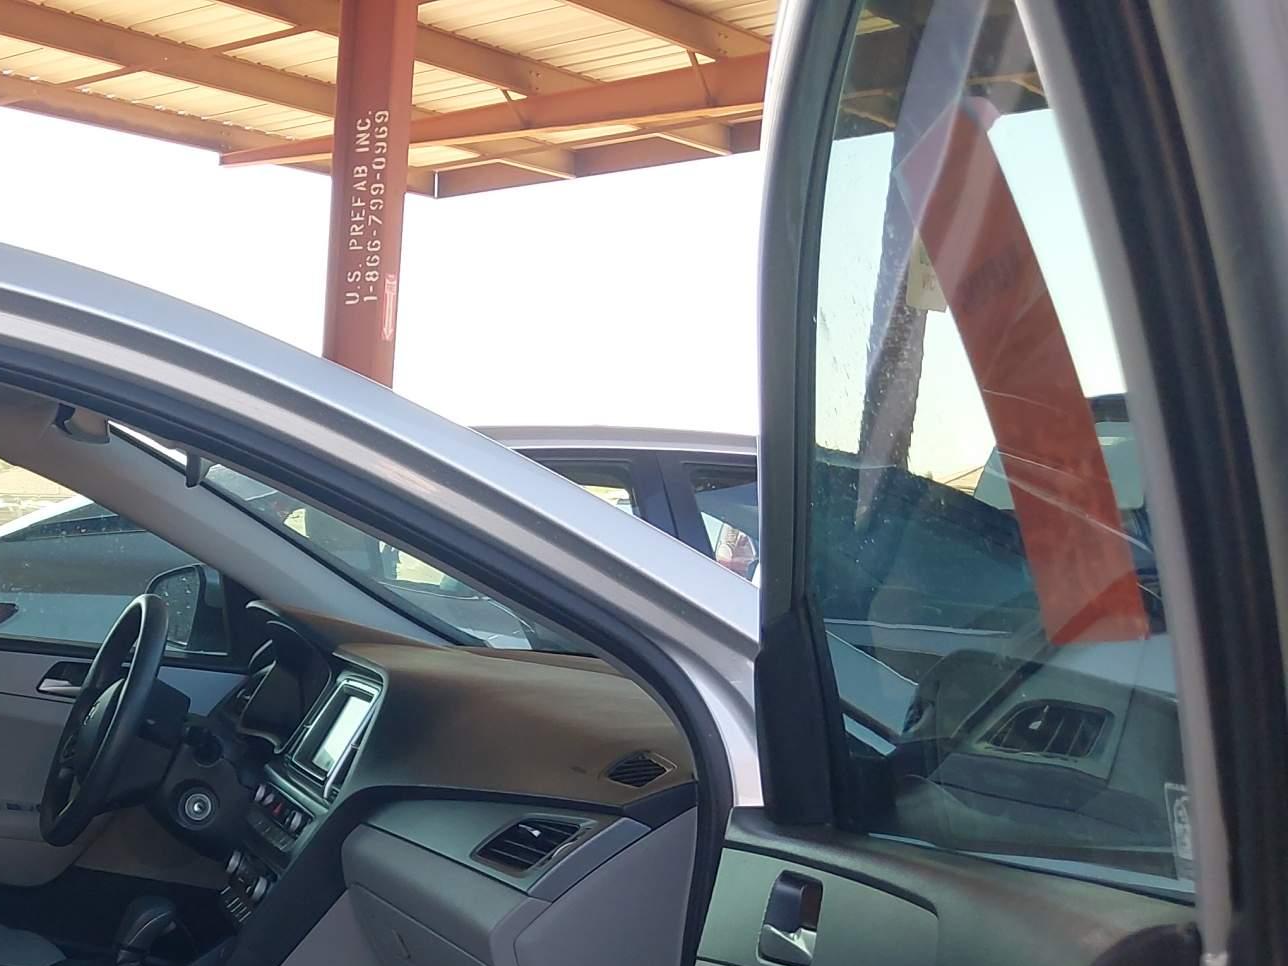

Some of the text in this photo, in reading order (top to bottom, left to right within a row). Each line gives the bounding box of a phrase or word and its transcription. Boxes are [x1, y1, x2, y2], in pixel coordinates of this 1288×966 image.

[345, 110, 373, 305] U.S. PREFAB INC.
[363, 111, 389, 302] 1-866-799-0969
